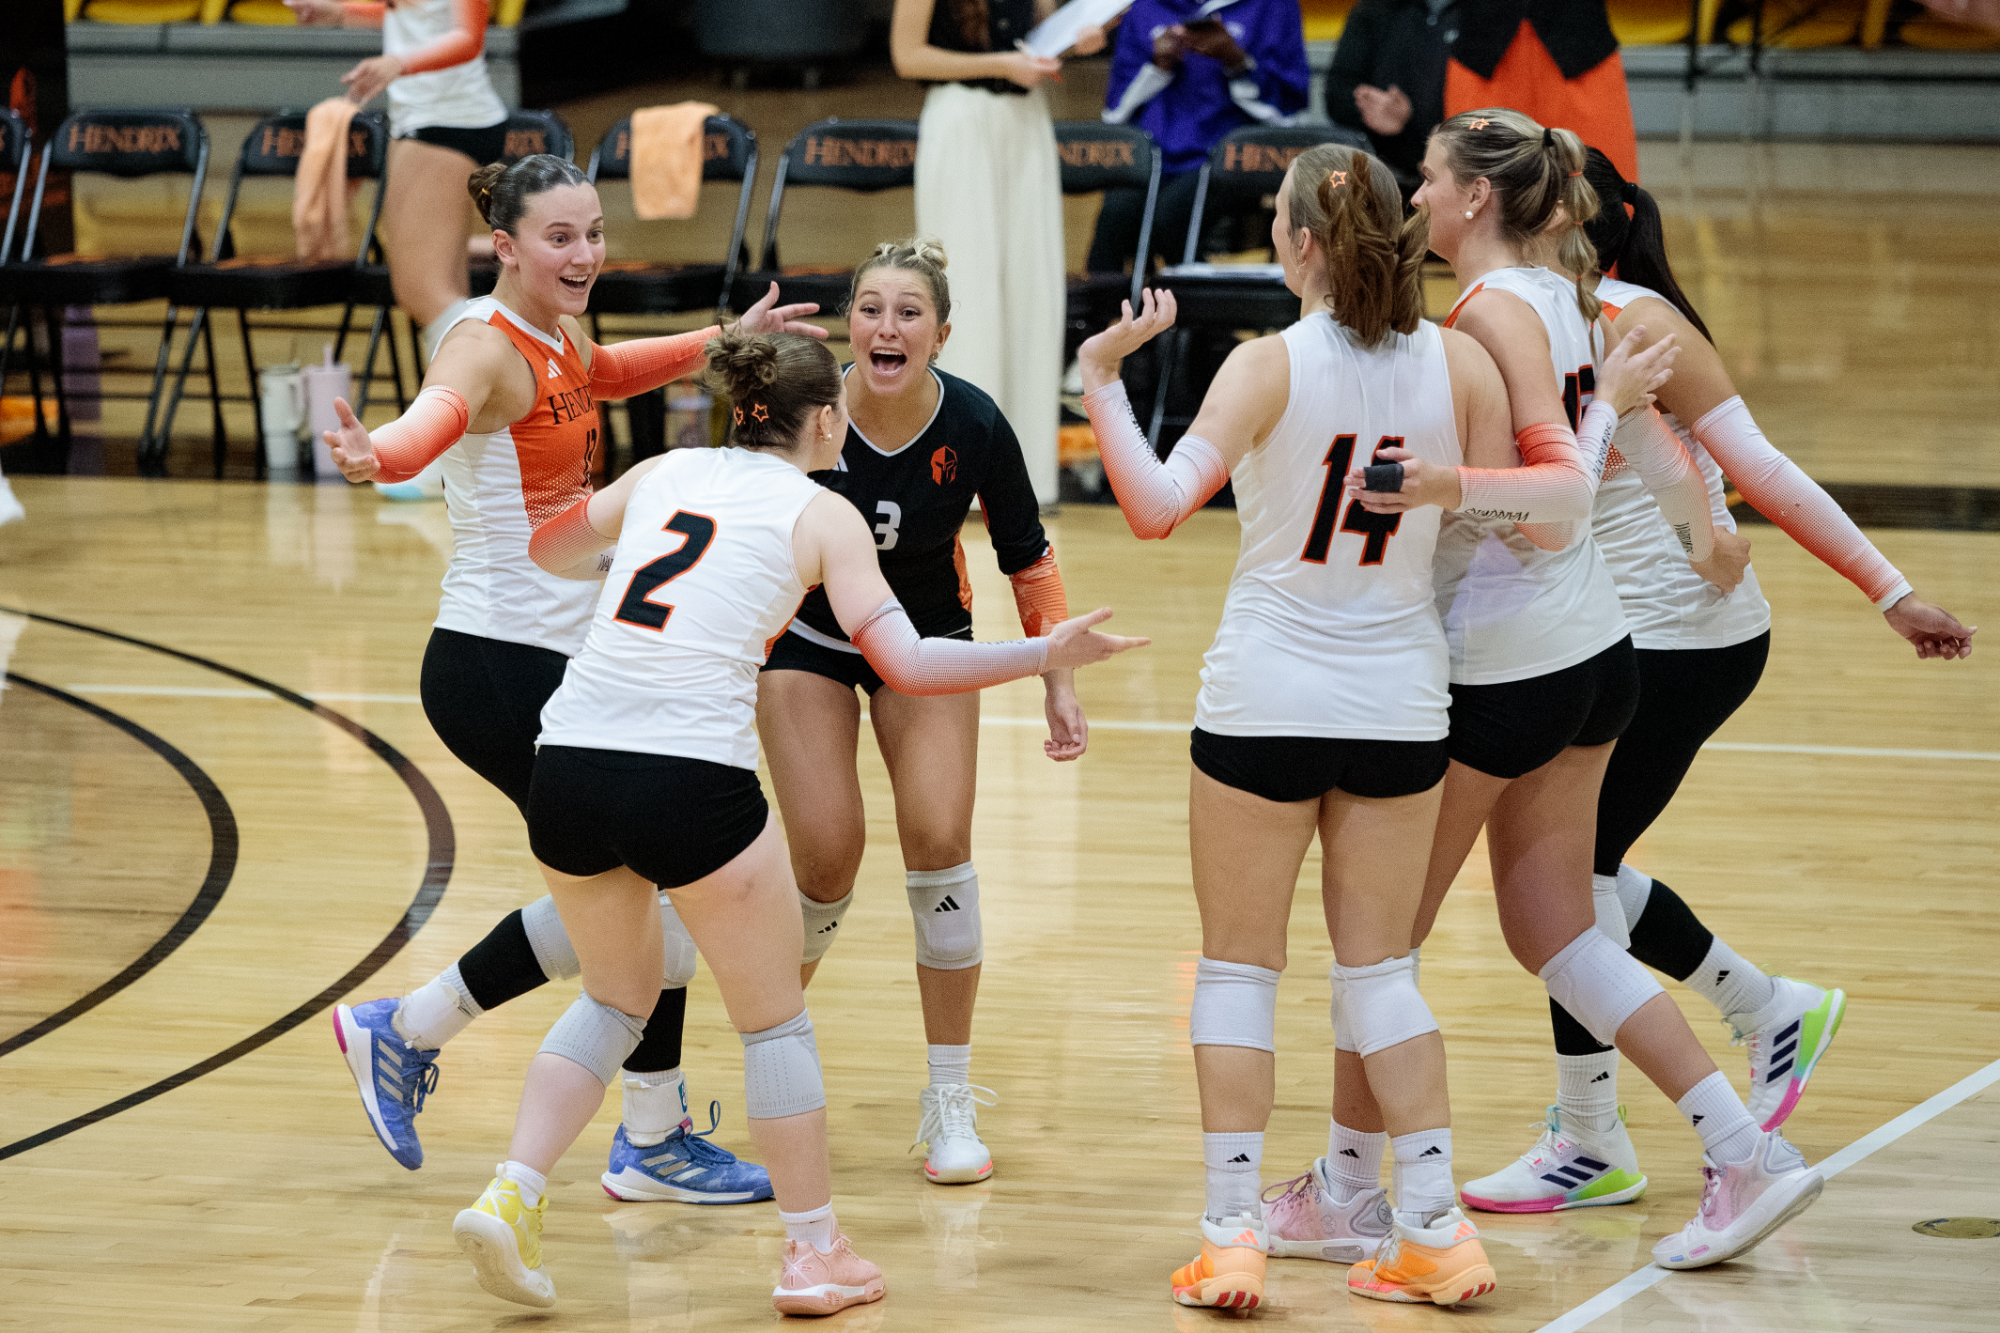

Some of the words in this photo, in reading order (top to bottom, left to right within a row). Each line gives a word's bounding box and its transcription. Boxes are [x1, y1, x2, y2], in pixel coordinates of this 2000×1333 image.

[68, 124, 181, 153] HENDRIX
[874, 500, 902, 550] 3
[1299, 433, 1405, 567] 14
[611, 509, 718, 633] 2
